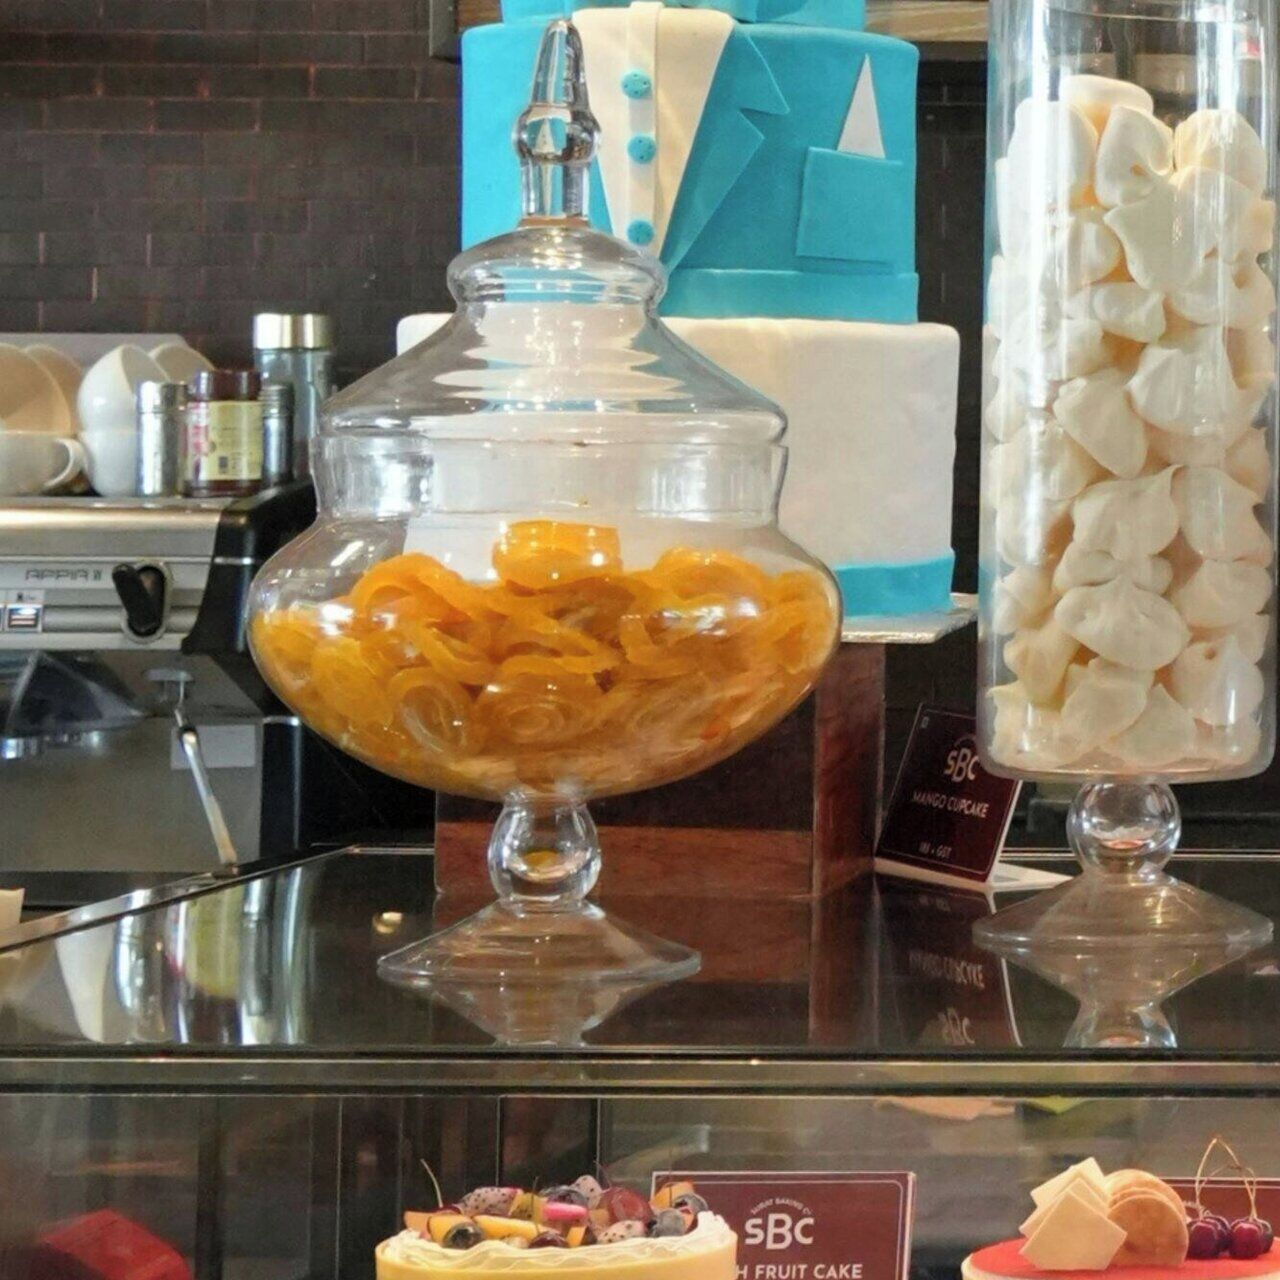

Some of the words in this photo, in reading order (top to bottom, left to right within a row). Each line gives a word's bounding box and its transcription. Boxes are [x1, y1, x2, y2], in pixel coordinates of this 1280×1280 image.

[943, 748, 979, 782] SBC
[913, 790, 946, 809] MANGO
[947, 797, 990, 818] CUPCAKE
[745, 1212, 815, 1250] SBC
[755, 1263, 807, 1280] FRUIT
[813, 1263, 863, 1280] CAKE
